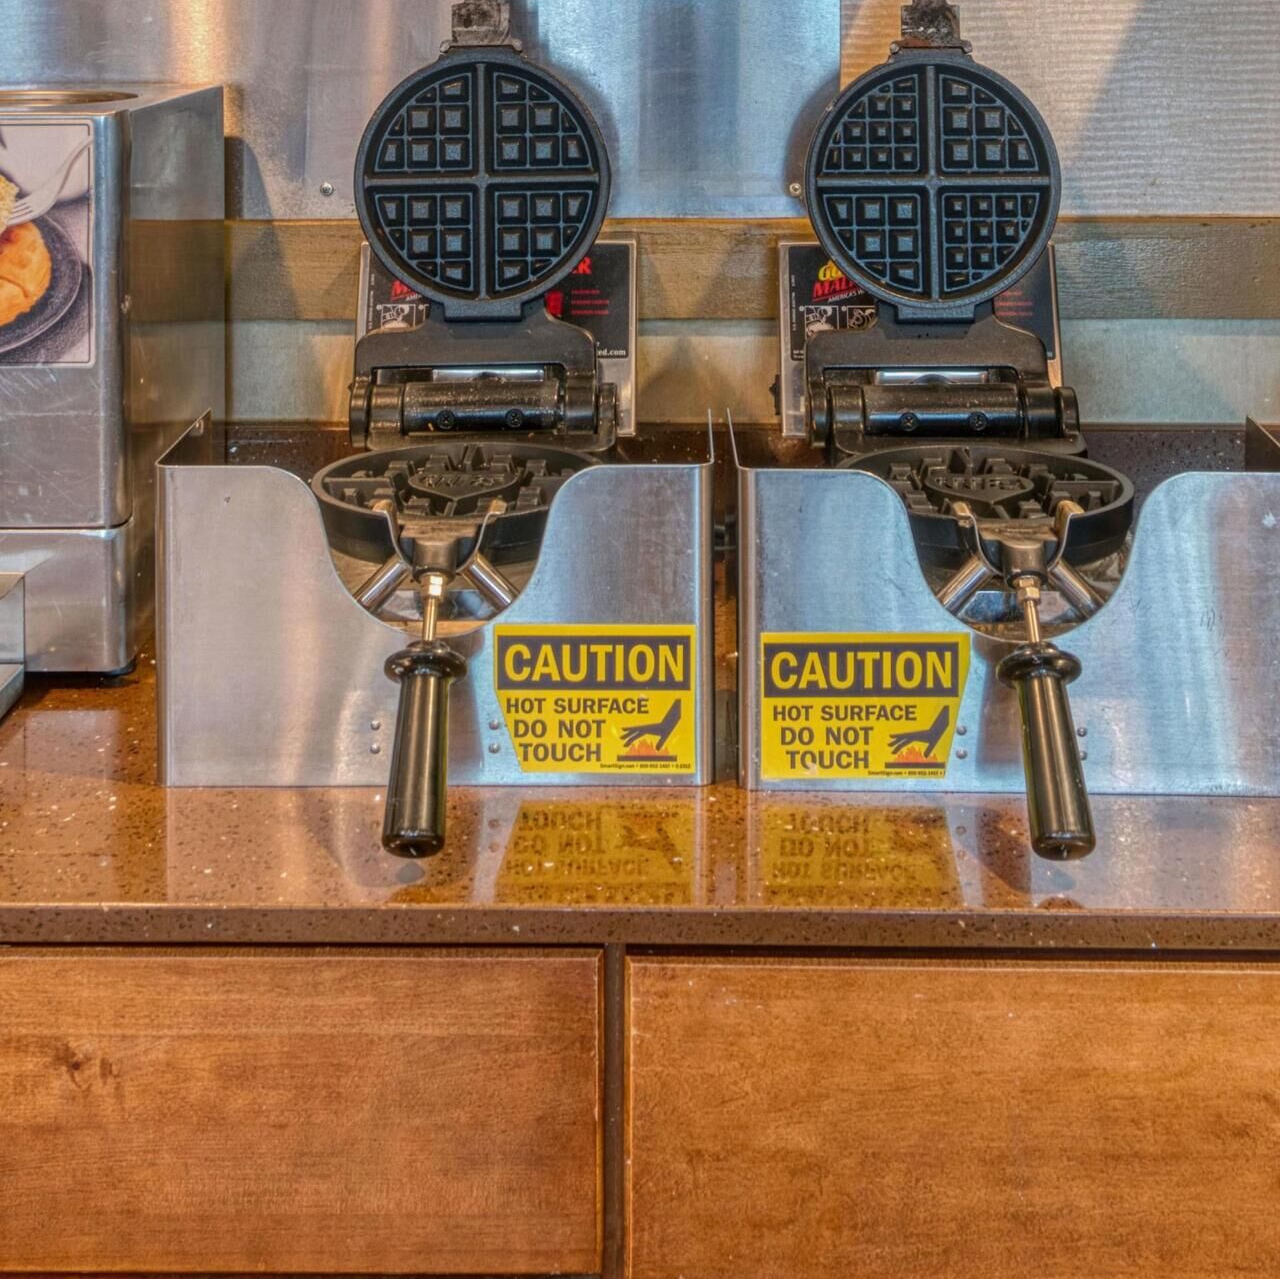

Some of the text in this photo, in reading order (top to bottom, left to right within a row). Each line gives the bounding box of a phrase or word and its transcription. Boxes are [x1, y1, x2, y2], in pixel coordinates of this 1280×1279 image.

[504, 643, 685, 683] CAUTION
[771, 651, 952, 690] CAUTION
[506, 697, 649, 714] HOT SURFACE
[773, 705, 917, 722] HOT SURFACE
[513, 719, 606, 738] DO NOT
[780, 726, 874, 746] DO NOT
[518, 743, 601, 762] TOUCH
[785, 750, 869, 770] TOUCH
